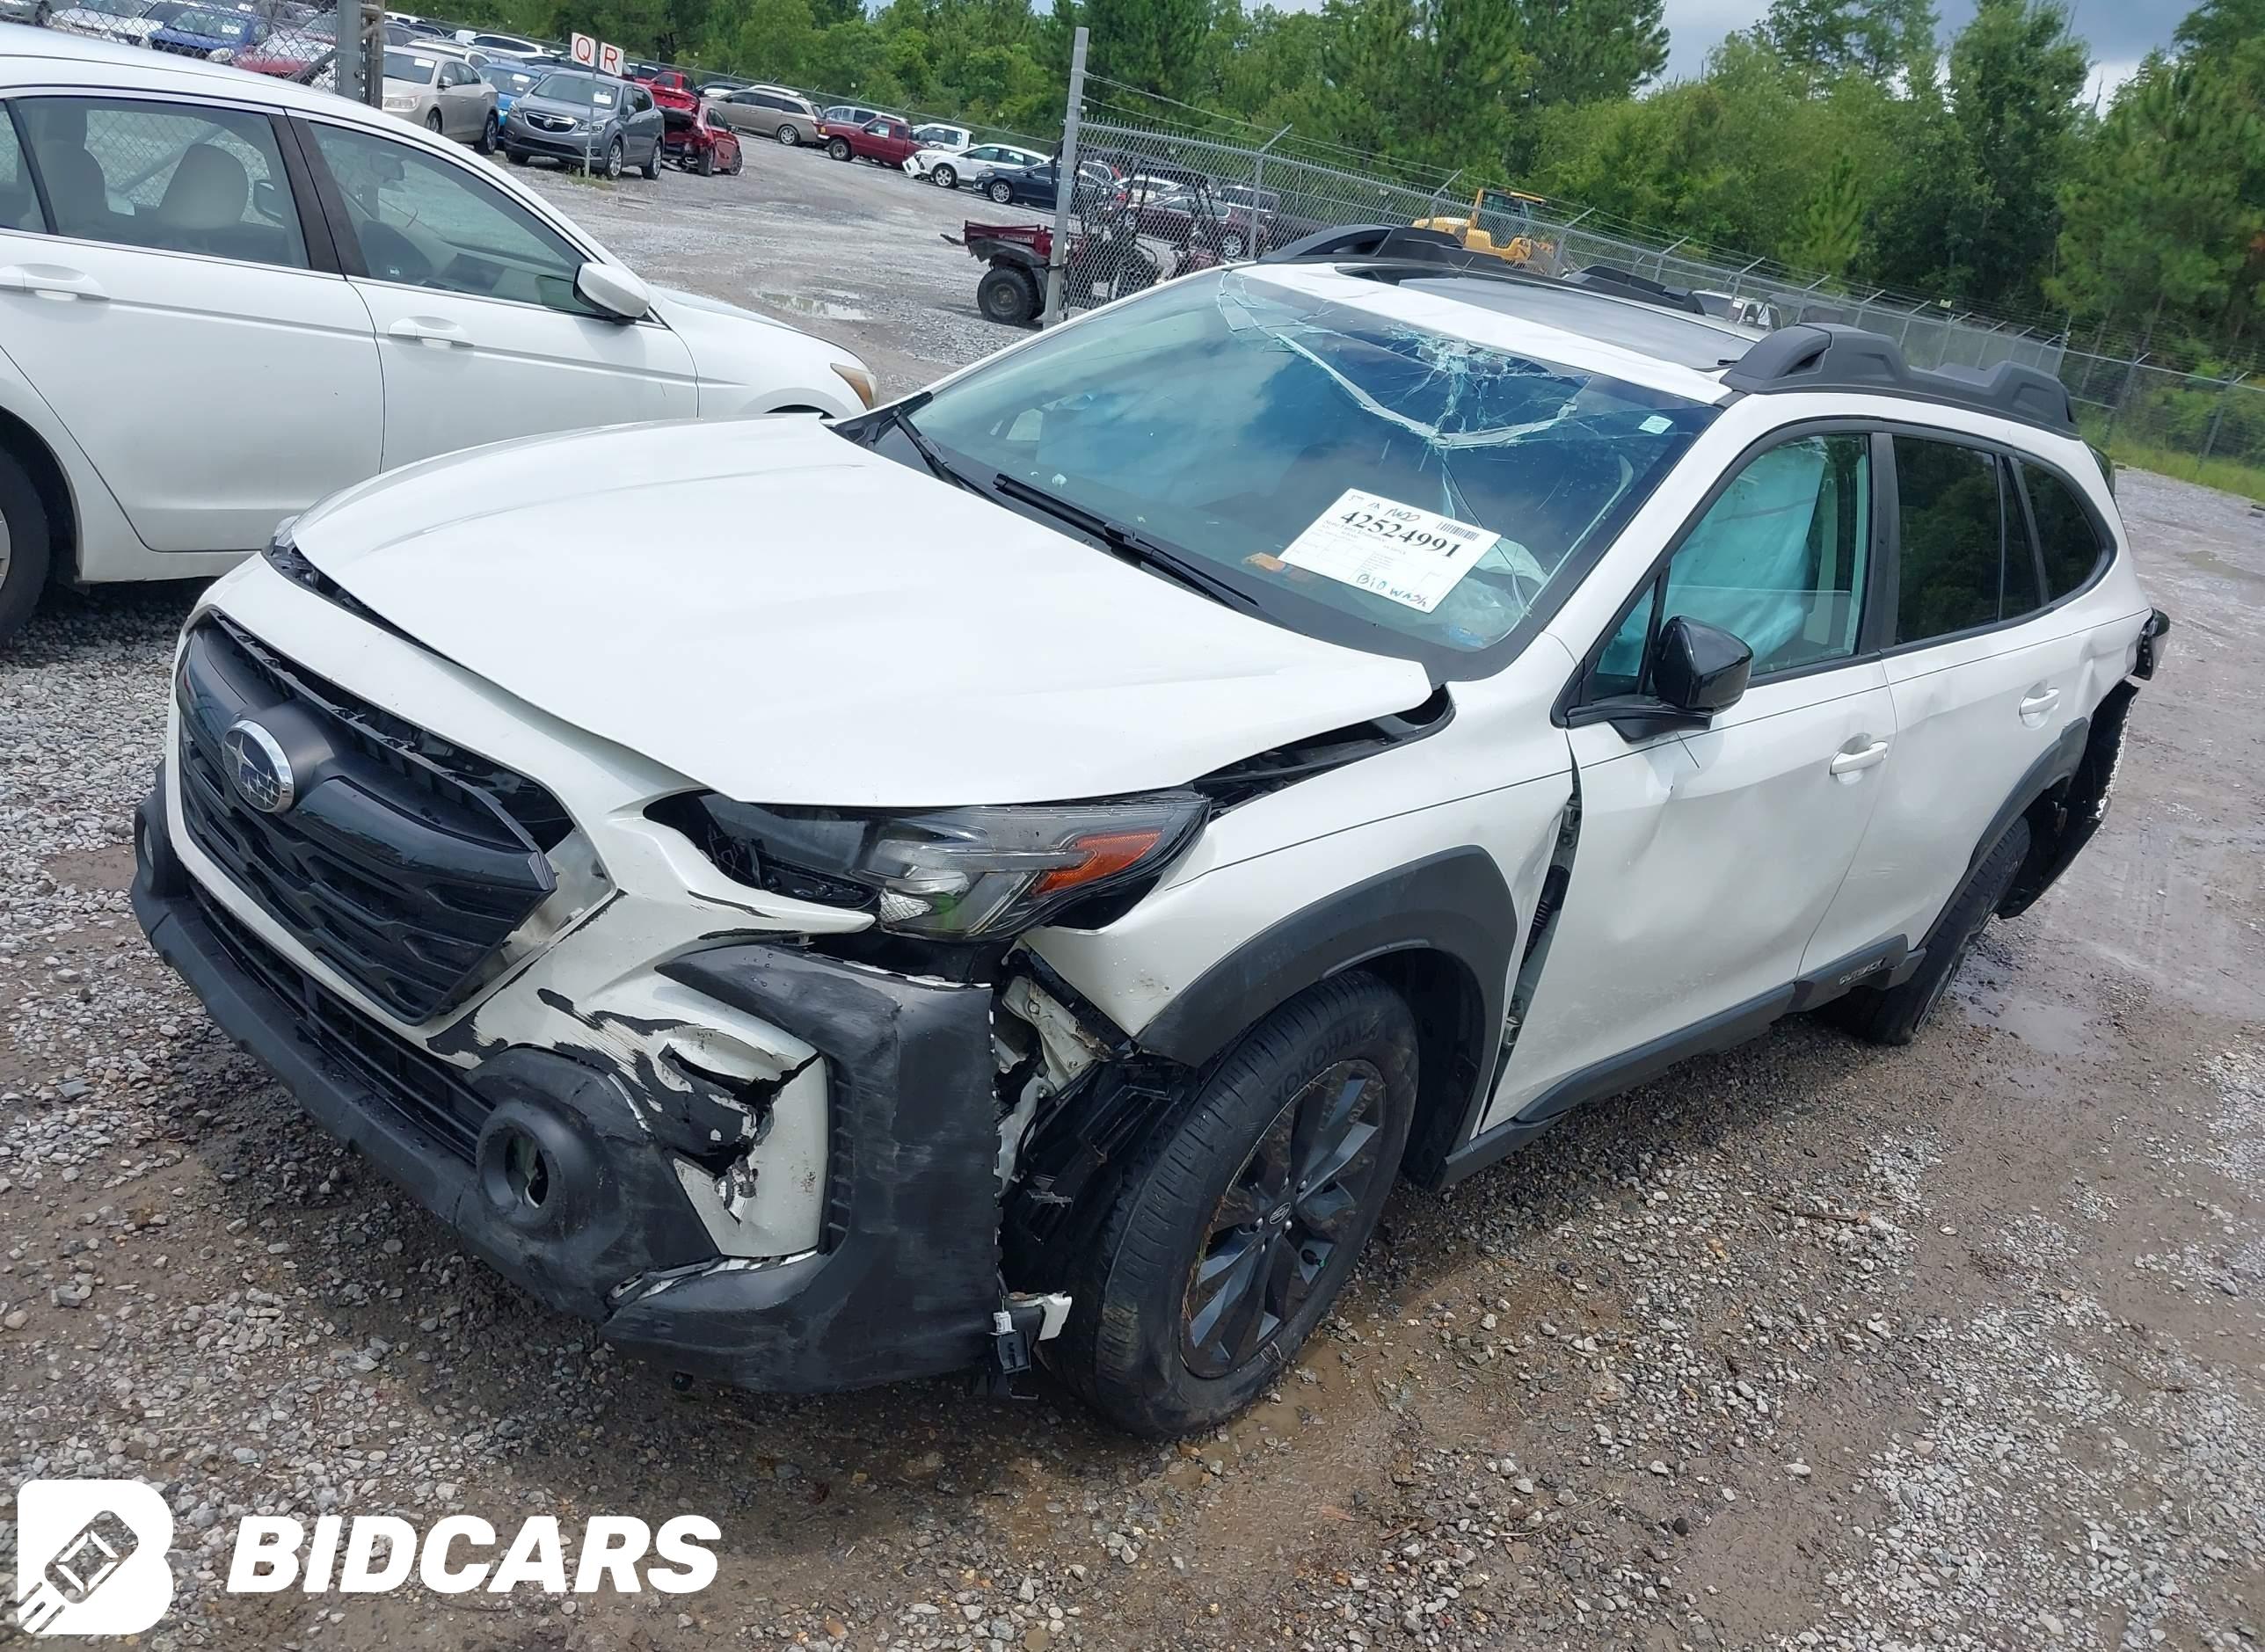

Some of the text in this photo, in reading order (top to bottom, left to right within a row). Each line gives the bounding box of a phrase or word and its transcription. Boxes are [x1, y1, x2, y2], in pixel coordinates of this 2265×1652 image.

[576, 37, 591, 64] Q
[603, 46, 618, 73] R
[1340, 511, 1461, 559] 42524991
